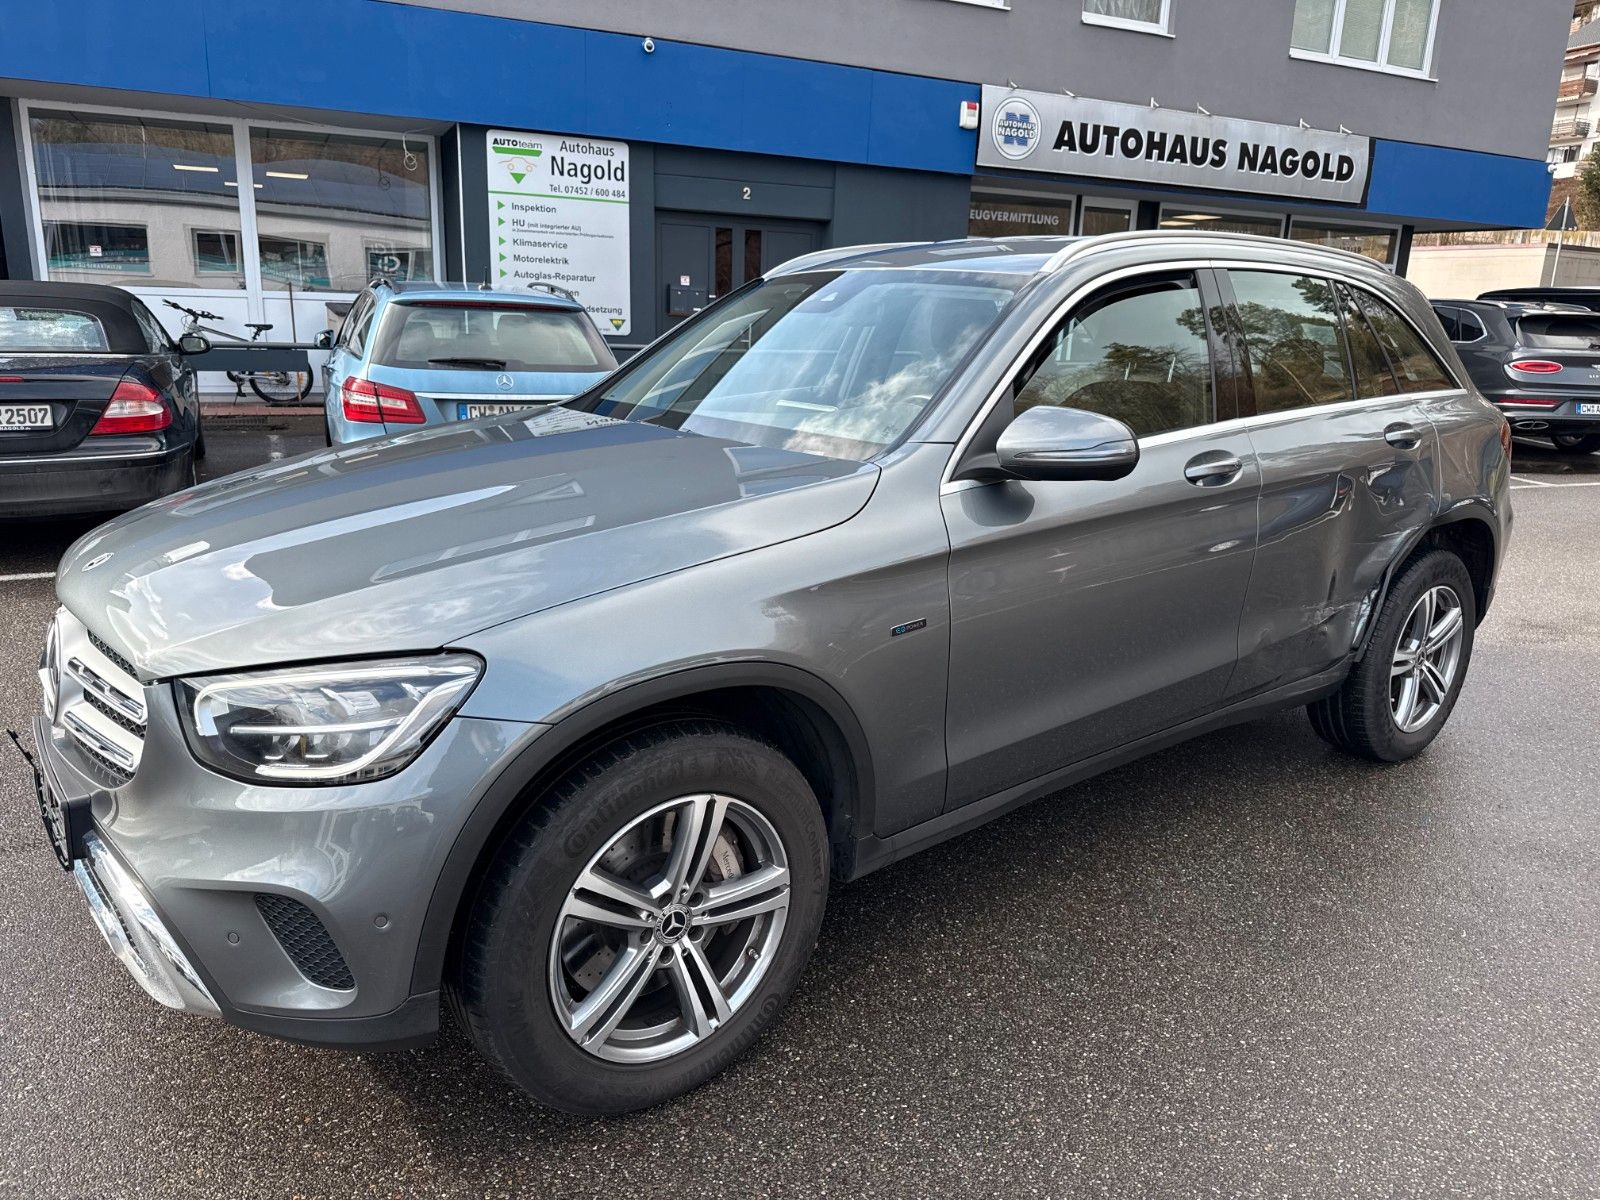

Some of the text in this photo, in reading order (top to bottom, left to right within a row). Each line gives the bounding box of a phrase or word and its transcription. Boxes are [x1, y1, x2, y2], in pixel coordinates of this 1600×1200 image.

[998, 119, 1036, 130] AUTOHAUS
[998, 127, 1036, 139] NAGOLD
[492, 138, 543, 149] AUTOteam
[560, 141, 615, 156] Autohaus
[1053, 120, 1356, 183] AUTOHAUS NAGOLD
[551, 156, 625, 184] Nagold
[549, 184, 563, 194] Tel.
[564, 186, 588, 196] 07452
[595, 189, 610, 197] 600
[611, 190, 625, 198] 484
[743, 187, 751, 200] 2
[511, 202, 557, 214] Inspektion
[512, 219, 525, 227] HU
[970, 209, 1059, 226] EUGVERMITTLUNG
[513, 238, 568, 250] Klimaservice
[513, 254, 569, 265] Motorelektrik
[513, 270, 596, 282] Autoglas-Reparatur
[4, 408, 48, 425] 2507
